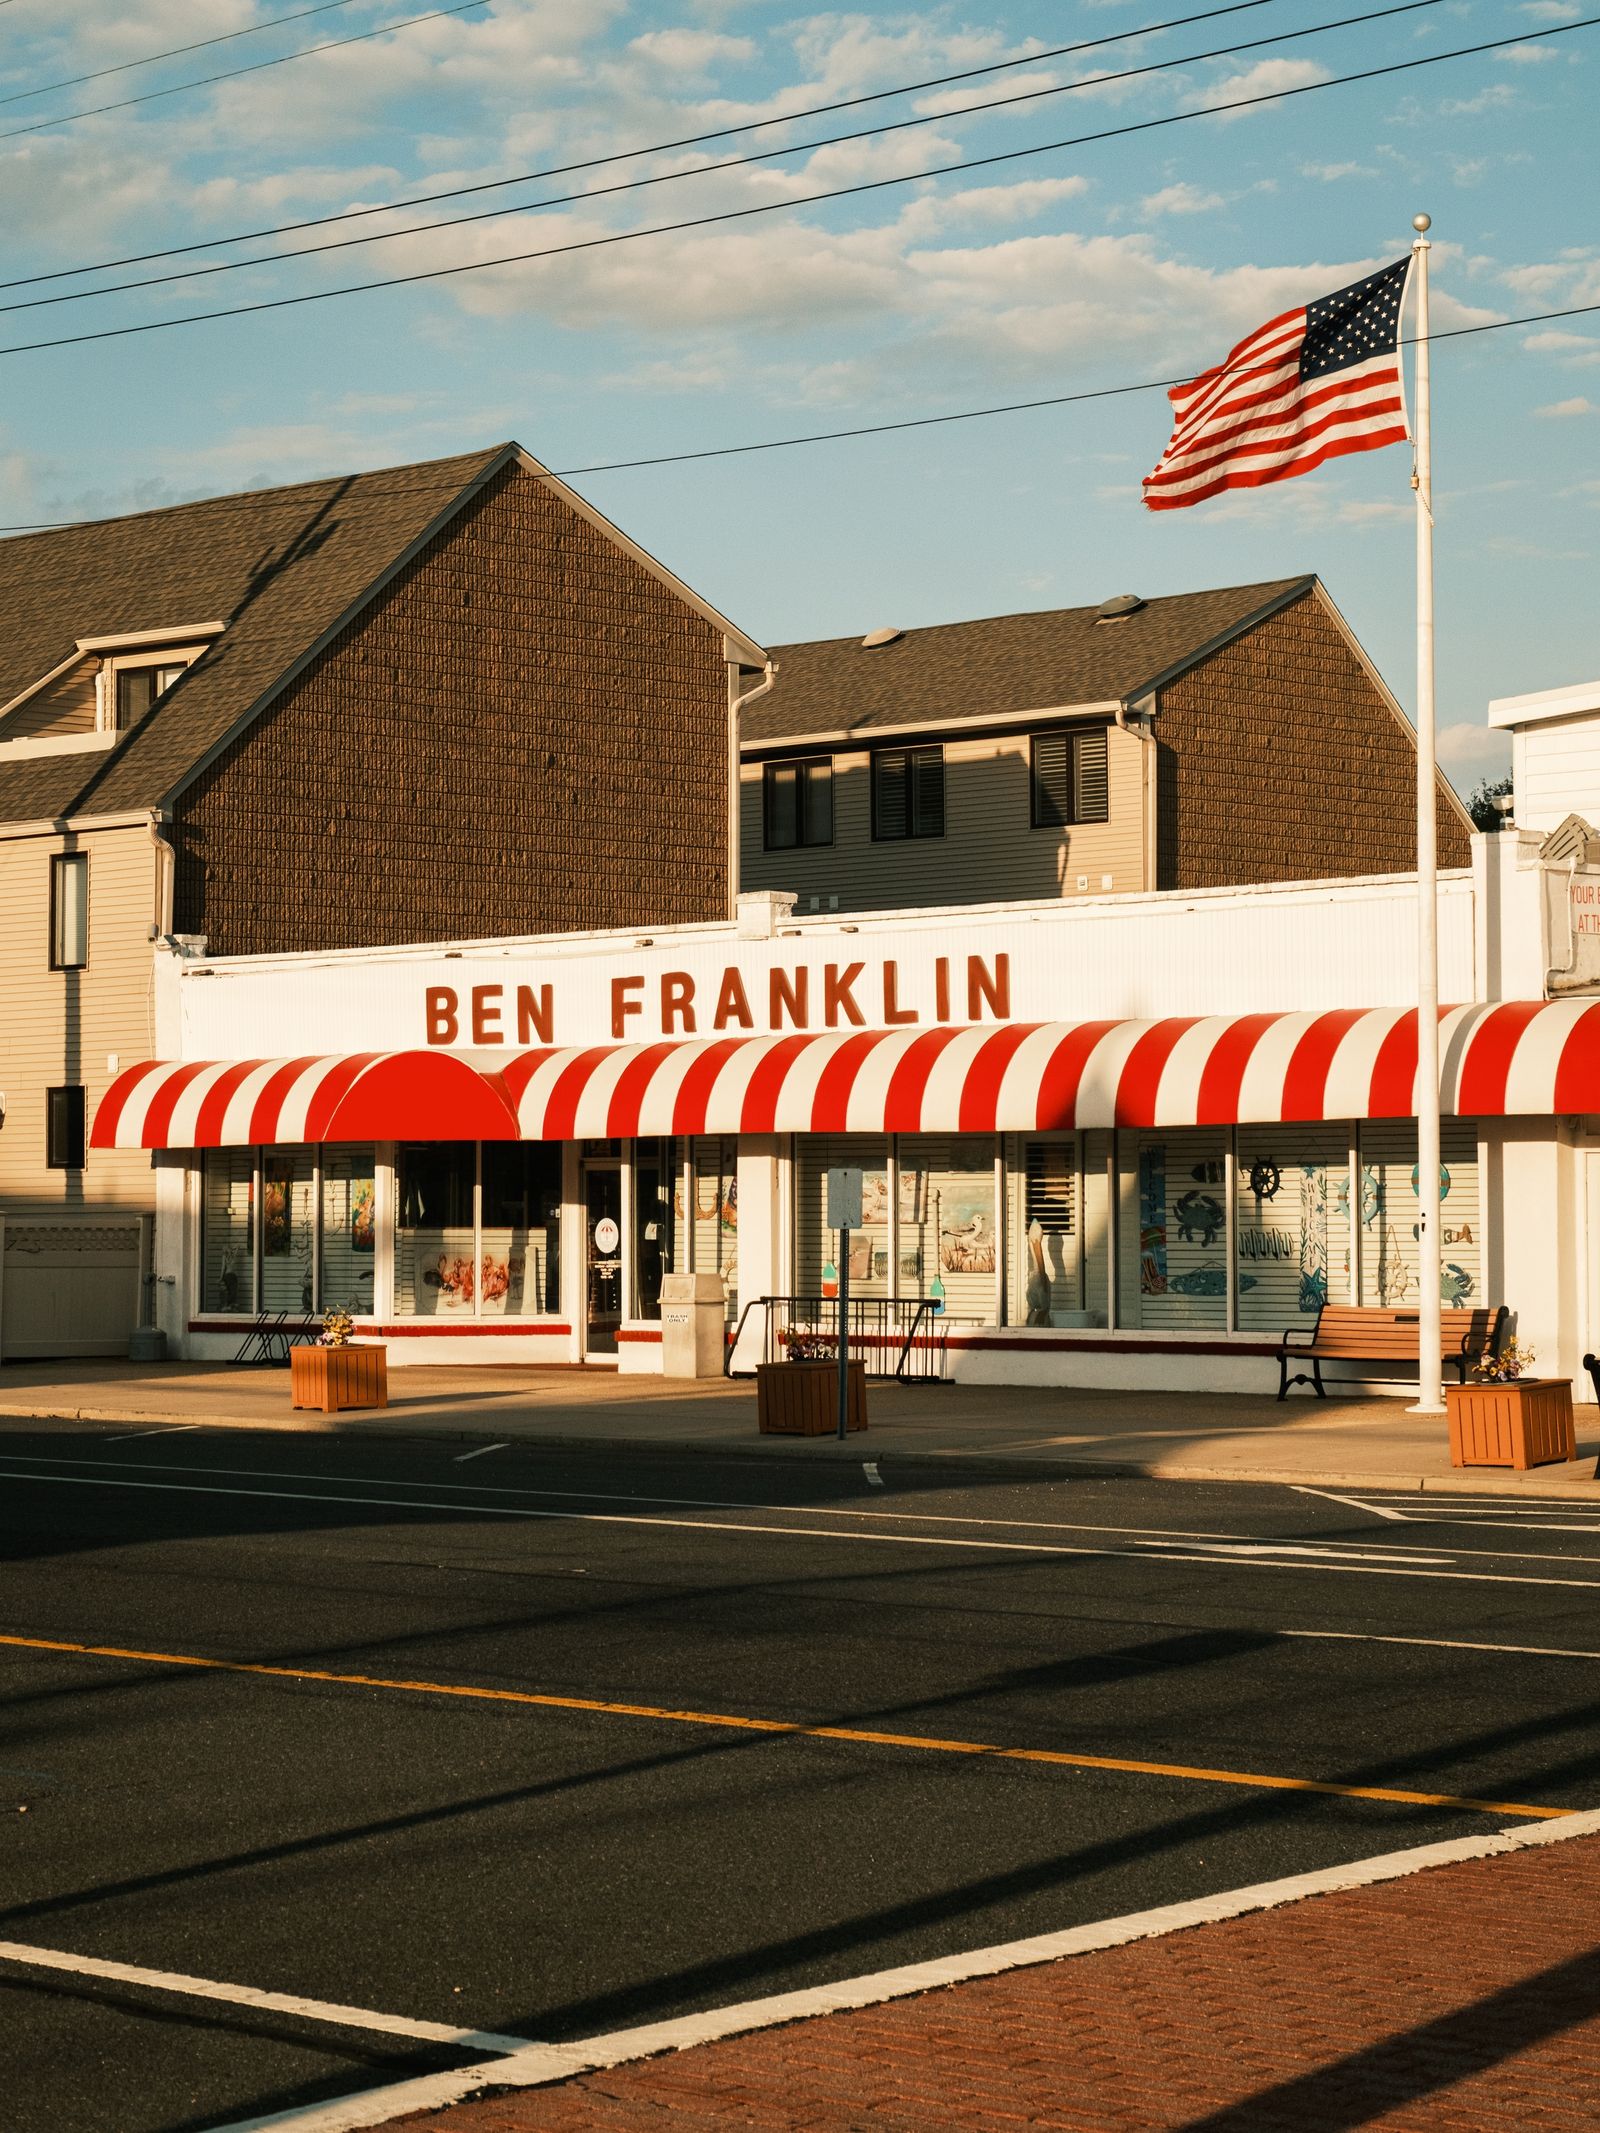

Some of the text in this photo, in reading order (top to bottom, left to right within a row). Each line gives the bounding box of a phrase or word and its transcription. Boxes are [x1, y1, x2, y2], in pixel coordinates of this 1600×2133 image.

[1570, 886, 1595, 904] YOUR
[1578, 914, 1589, 932] AT
[426, 953, 1010, 1045] BEN FRANKLIN
[1307, 1183, 1317, 1267] WELCOME
